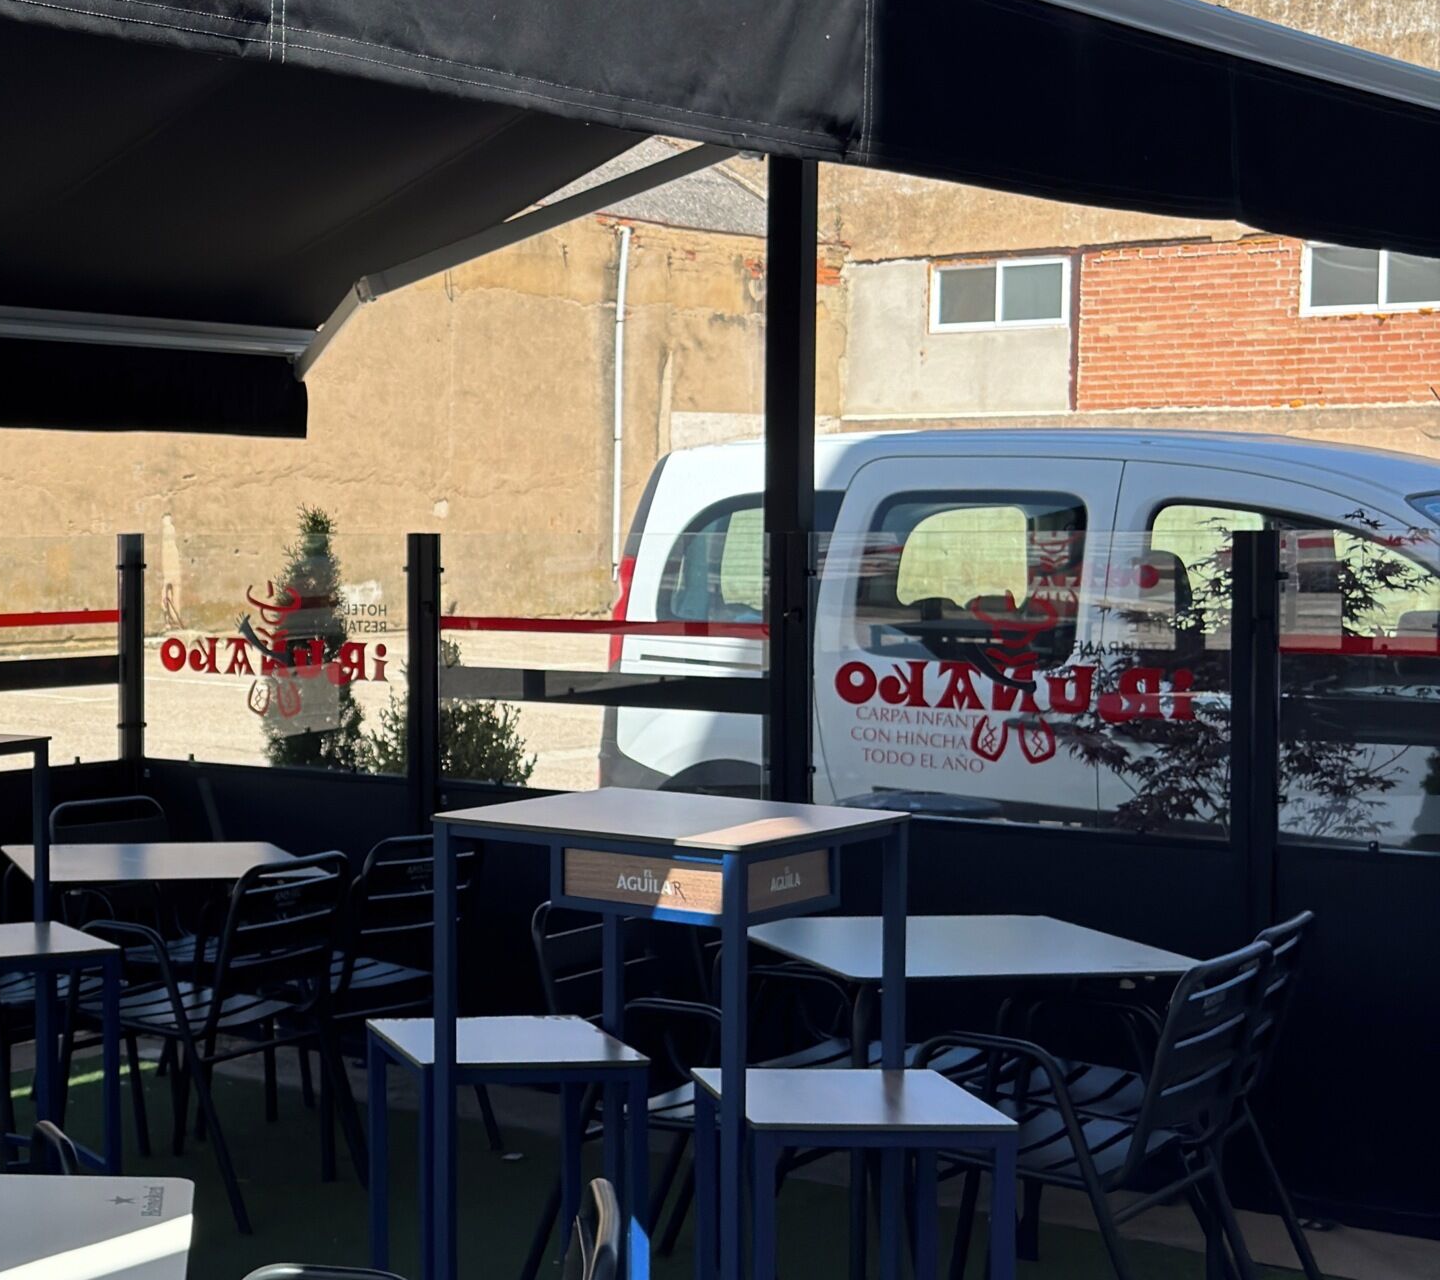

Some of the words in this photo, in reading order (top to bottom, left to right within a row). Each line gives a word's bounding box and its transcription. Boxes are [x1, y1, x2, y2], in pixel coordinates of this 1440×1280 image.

[855, 706, 910, 724] CARPA
[850, 726, 891, 743] CON
[862, 747, 915, 767] TODO
[920, 753, 937, 769] EL
[942, 753, 985, 774] AÑO
